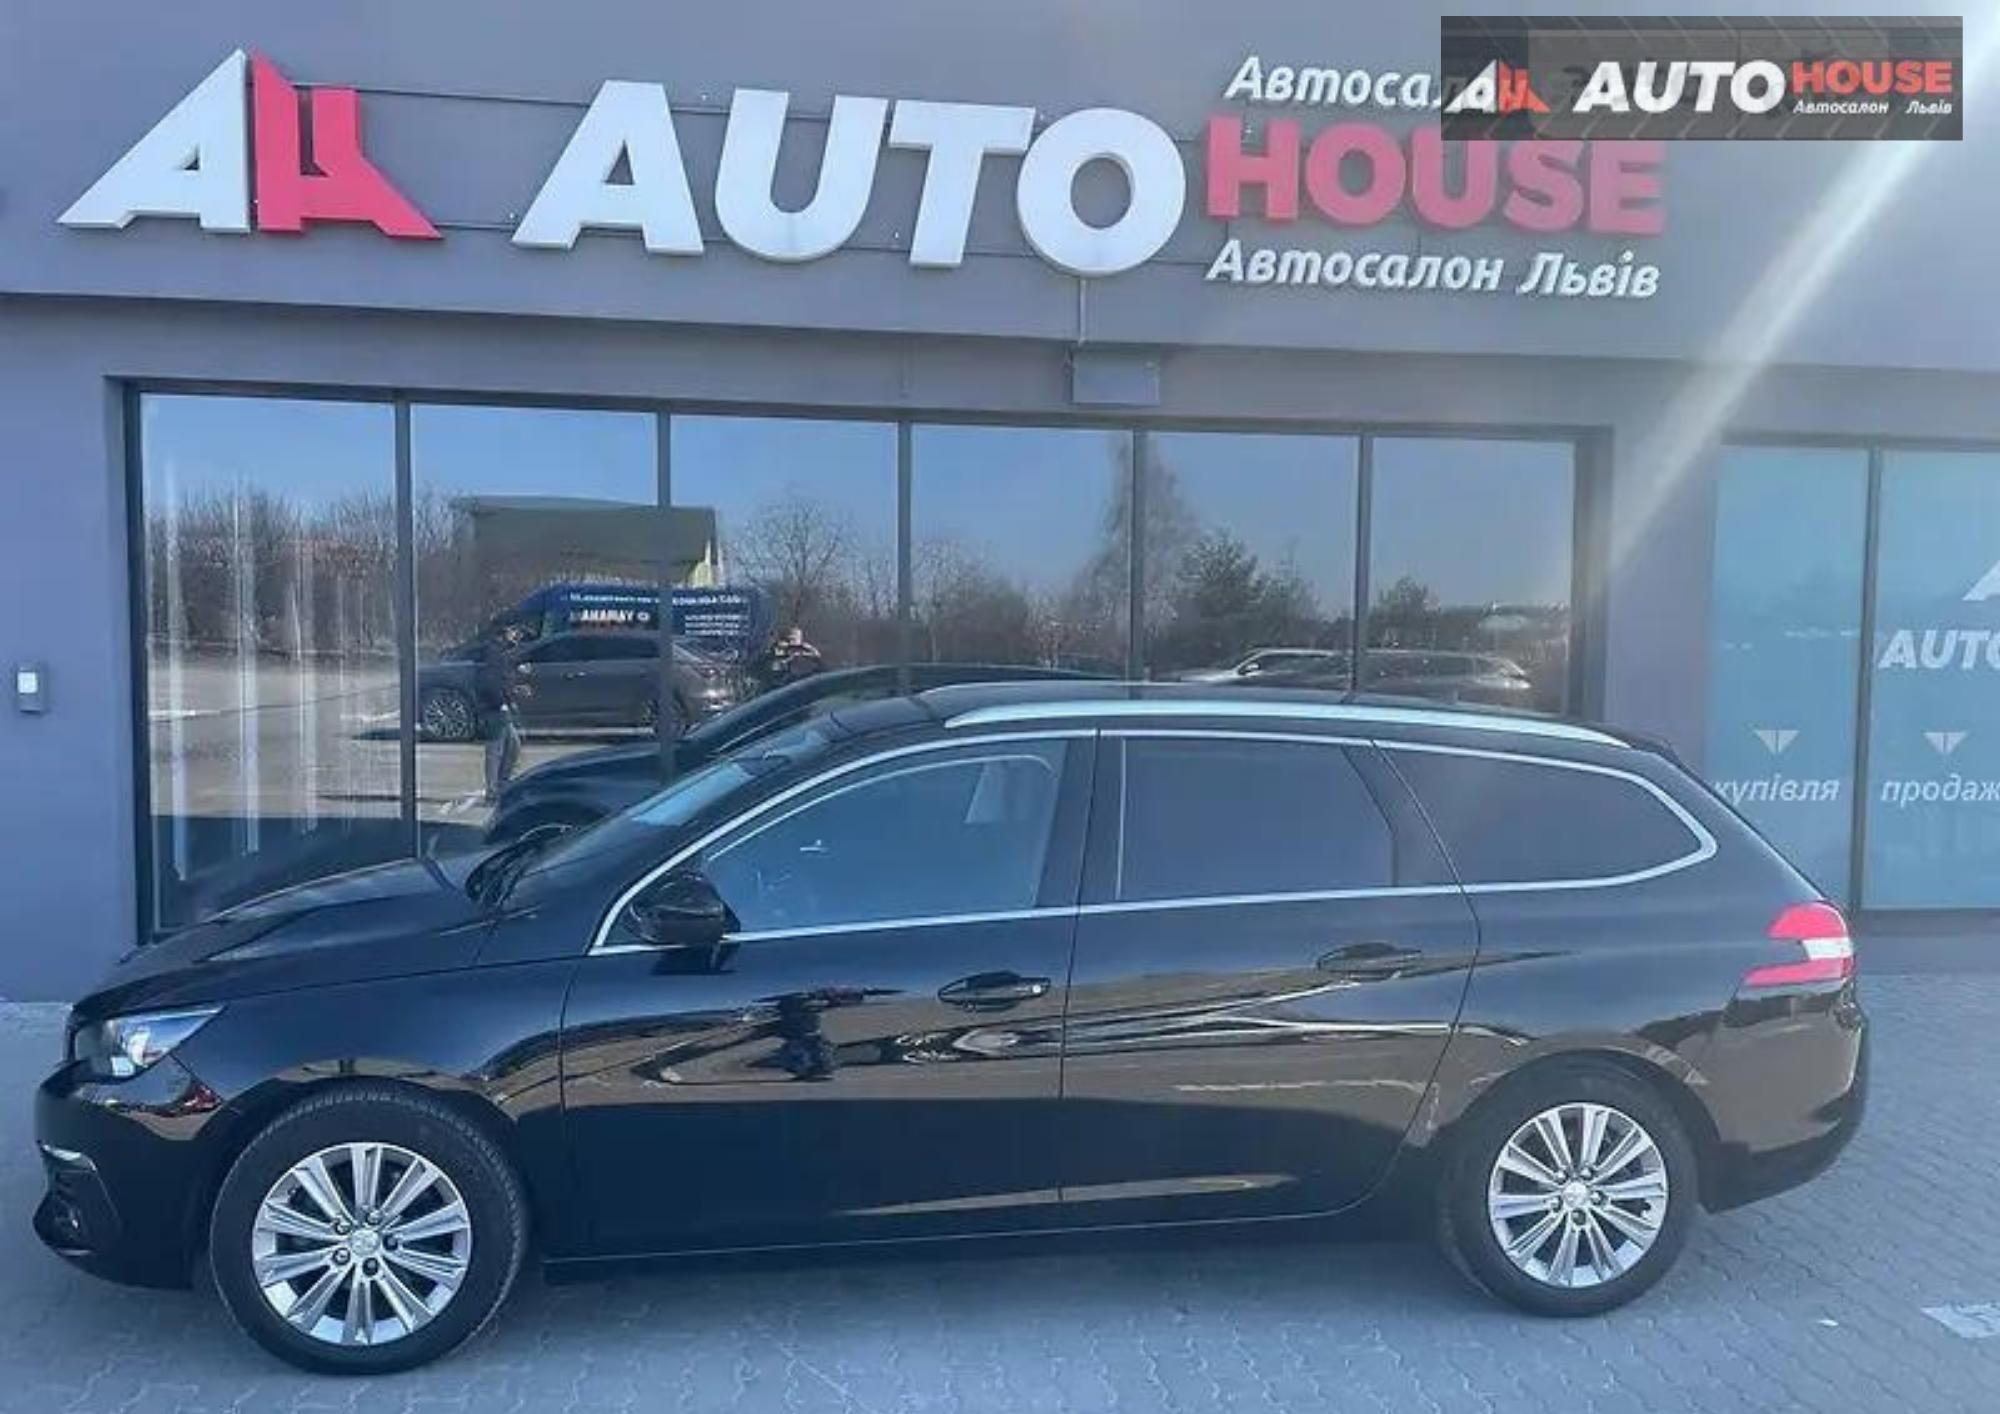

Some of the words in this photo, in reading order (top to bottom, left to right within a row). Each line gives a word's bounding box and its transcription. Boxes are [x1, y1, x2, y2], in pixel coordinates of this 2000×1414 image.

[511, 79, 1187, 277] AUTO
[1207, 116, 1664, 234] HOUSE
[1205, 239, 1504, 292] Автосалон
[1515, 250, 1661, 299] Львів
